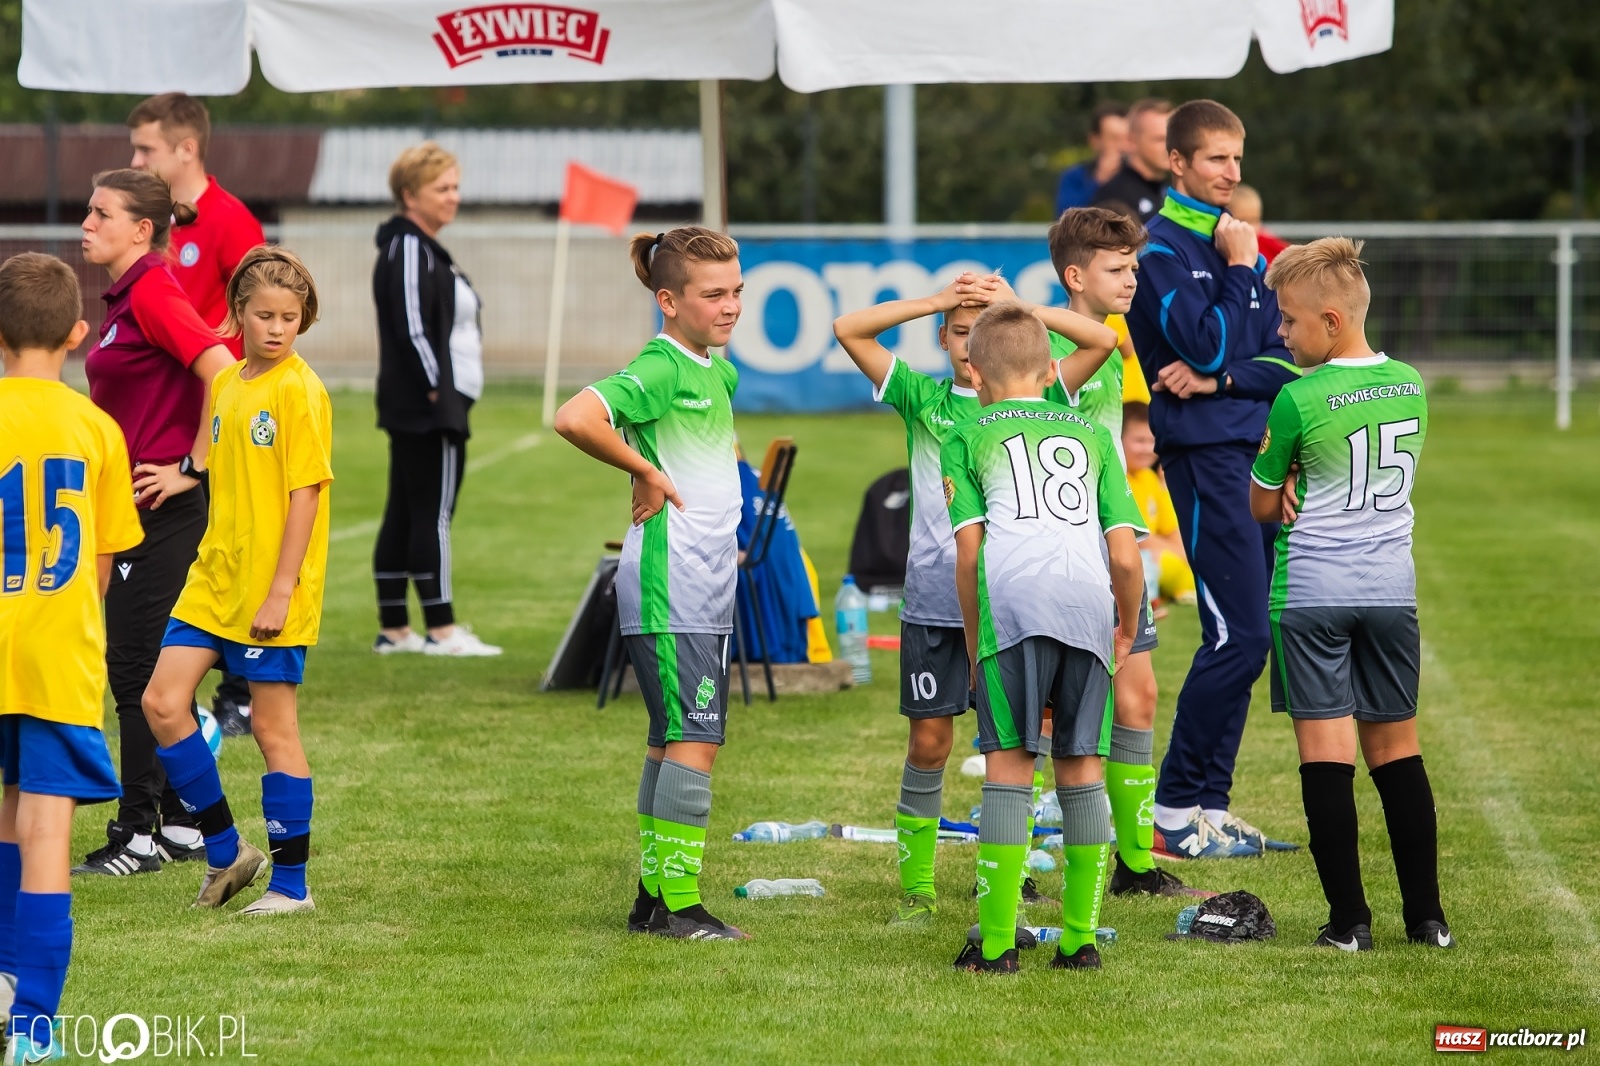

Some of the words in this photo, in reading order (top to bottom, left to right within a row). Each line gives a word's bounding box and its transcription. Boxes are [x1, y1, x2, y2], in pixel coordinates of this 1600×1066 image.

[451, 8, 588, 48] ŻYWIEC
[1327, 383, 1421, 411] ŻYWIECCZYZNA
[1001, 432, 1089, 525] 18
[1343, 417, 1419, 512] 15
[0, 456, 88, 595] 15
[910, 672, 937, 700] 10
[687, 712, 719, 720] CUTLINE
[1199, 913, 1237, 928] MARVEL
